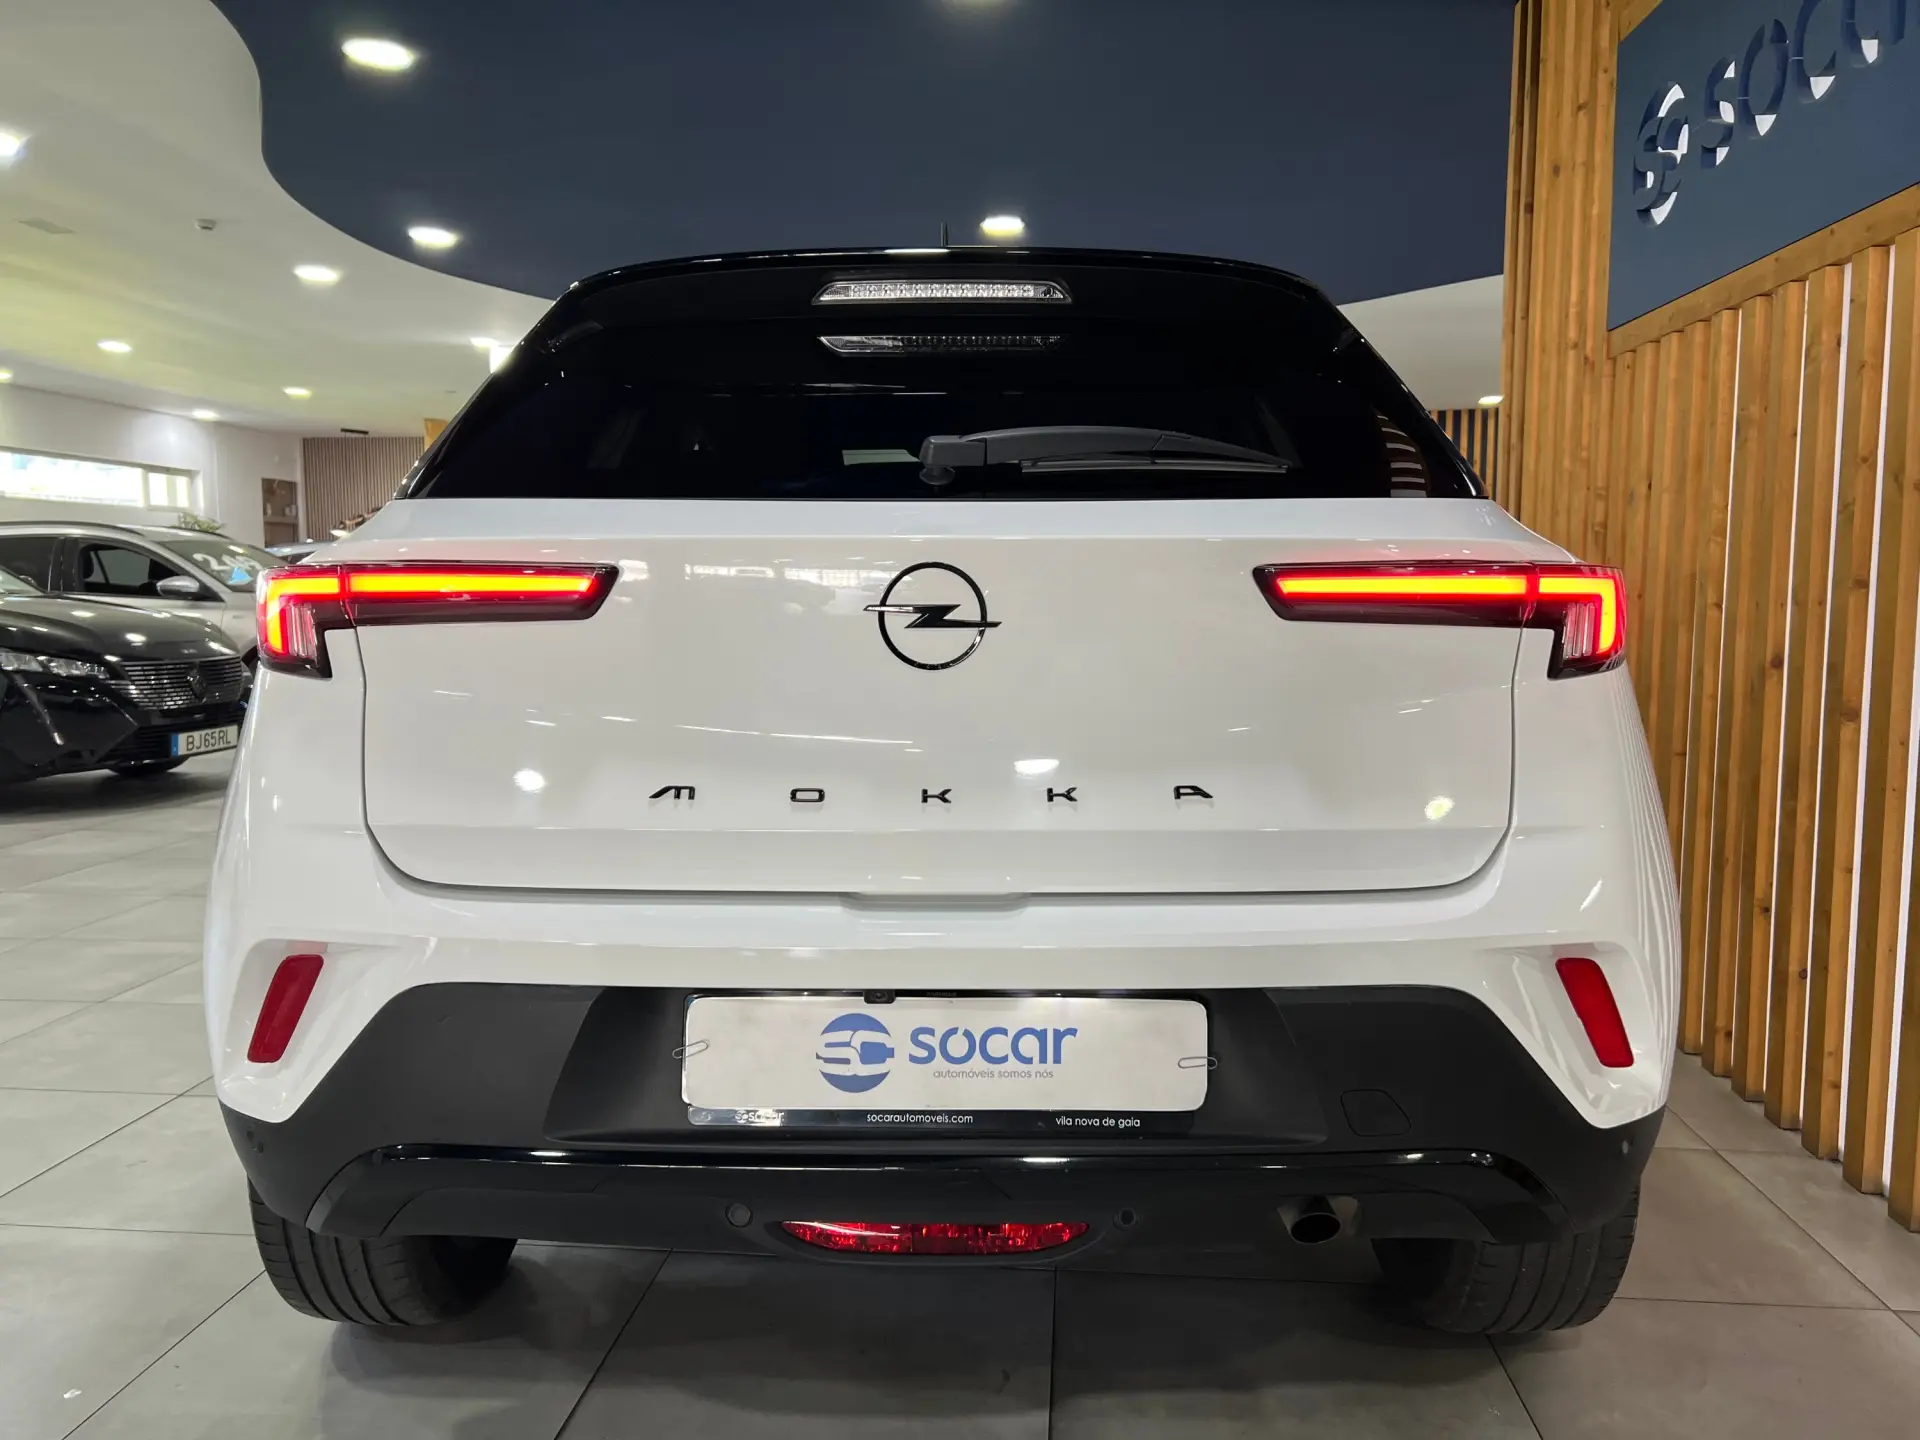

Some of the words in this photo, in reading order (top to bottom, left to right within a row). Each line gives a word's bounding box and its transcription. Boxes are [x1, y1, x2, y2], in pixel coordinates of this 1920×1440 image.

[908, 1026, 1078, 1065] socar
[933, 1068, 995, 1079] automóveis
[998, 1070, 1032, 1079] somos
[1035, 1068, 1054, 1079] nós
[866, 1113, 974, 1123] socarautomoveis.com
[1055, 1116, 1072, 1126] vila
[1075, 1117, 1100, 1126] nova
[1102, 1117, 1116, 1126] de
[1118, 1117, 1140, 1129] gaia
